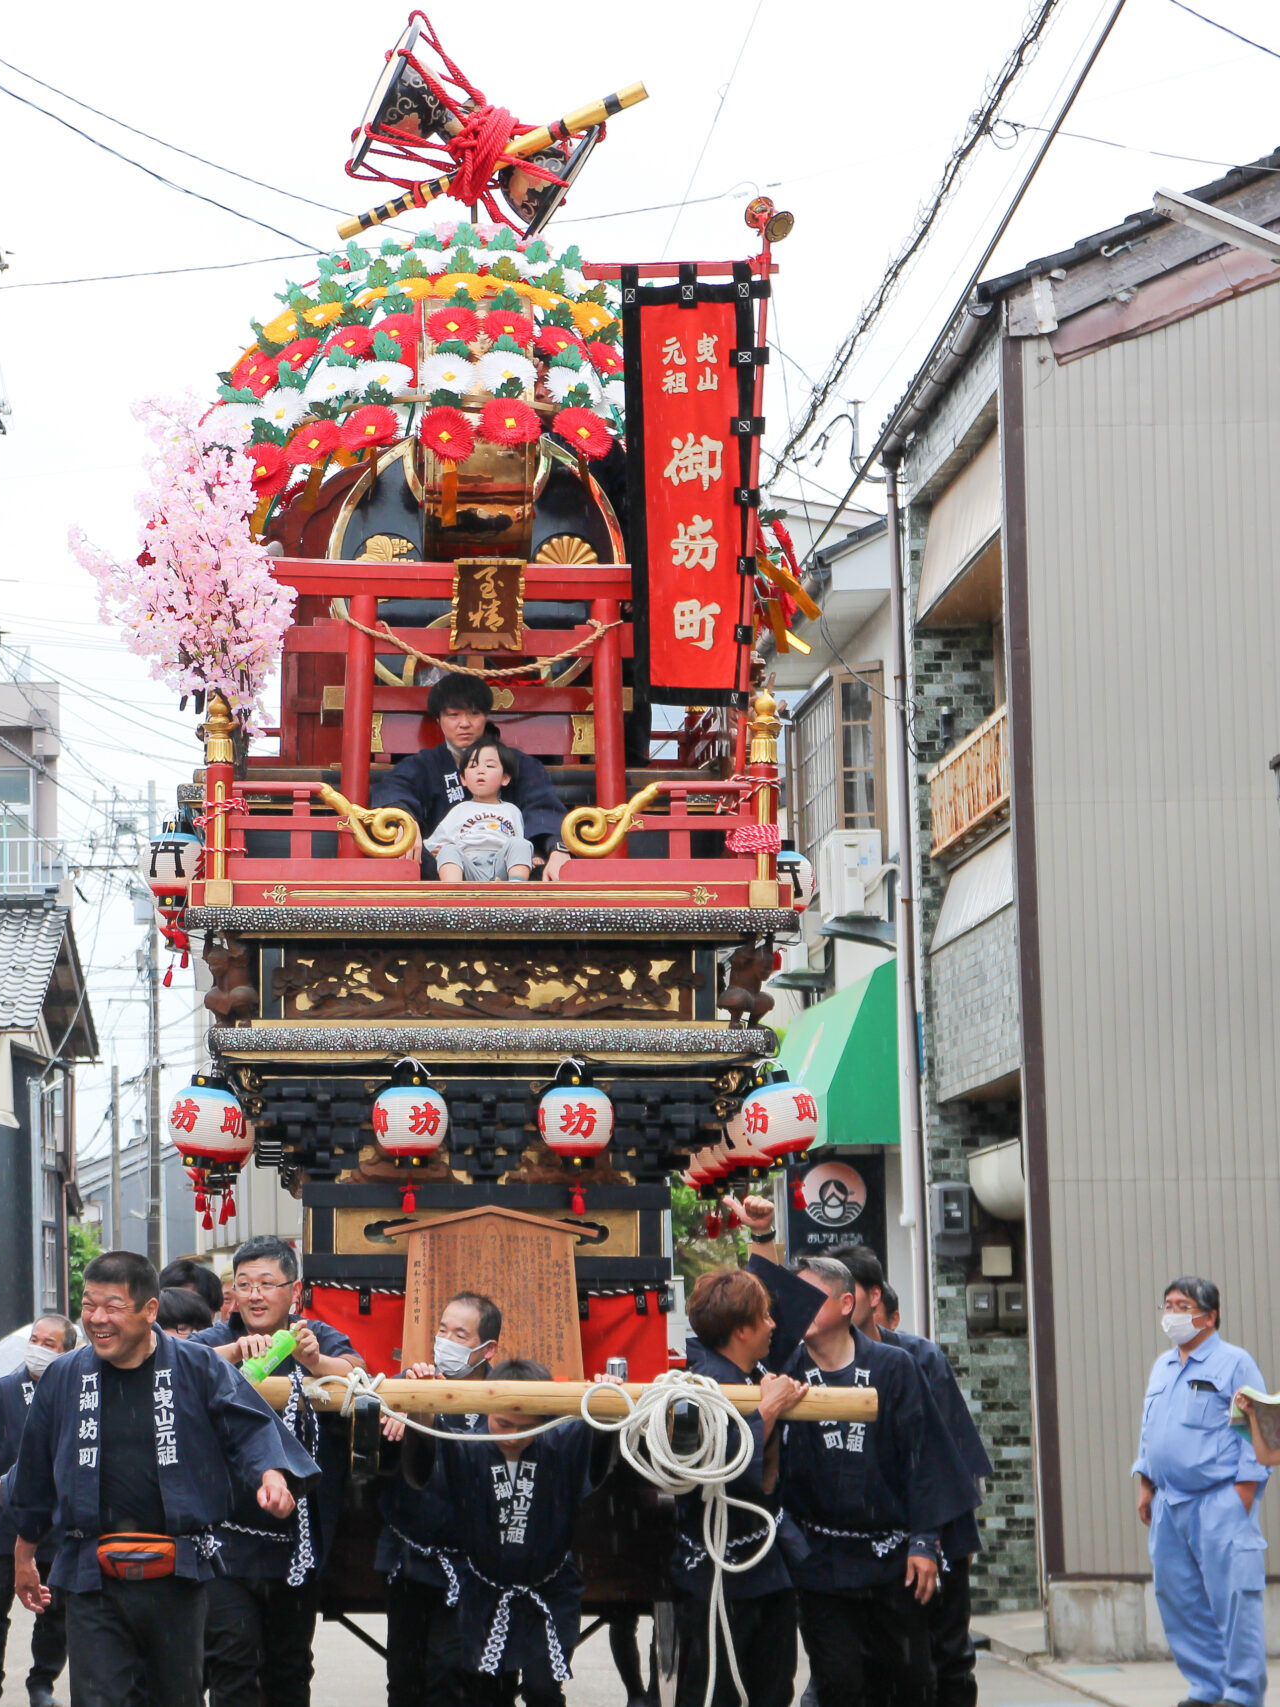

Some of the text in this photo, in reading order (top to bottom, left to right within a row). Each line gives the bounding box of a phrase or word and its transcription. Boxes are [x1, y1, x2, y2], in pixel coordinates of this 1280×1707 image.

[661, 336, 689, 395] 元祖
[663, 432, 724, 651] 御坊町
[78, 1391, 99, 1468] 御坊町
[153, 1387, 179, 1467] 曳山元祖
[506, 1477, 535, 1545] 曳山元祖
